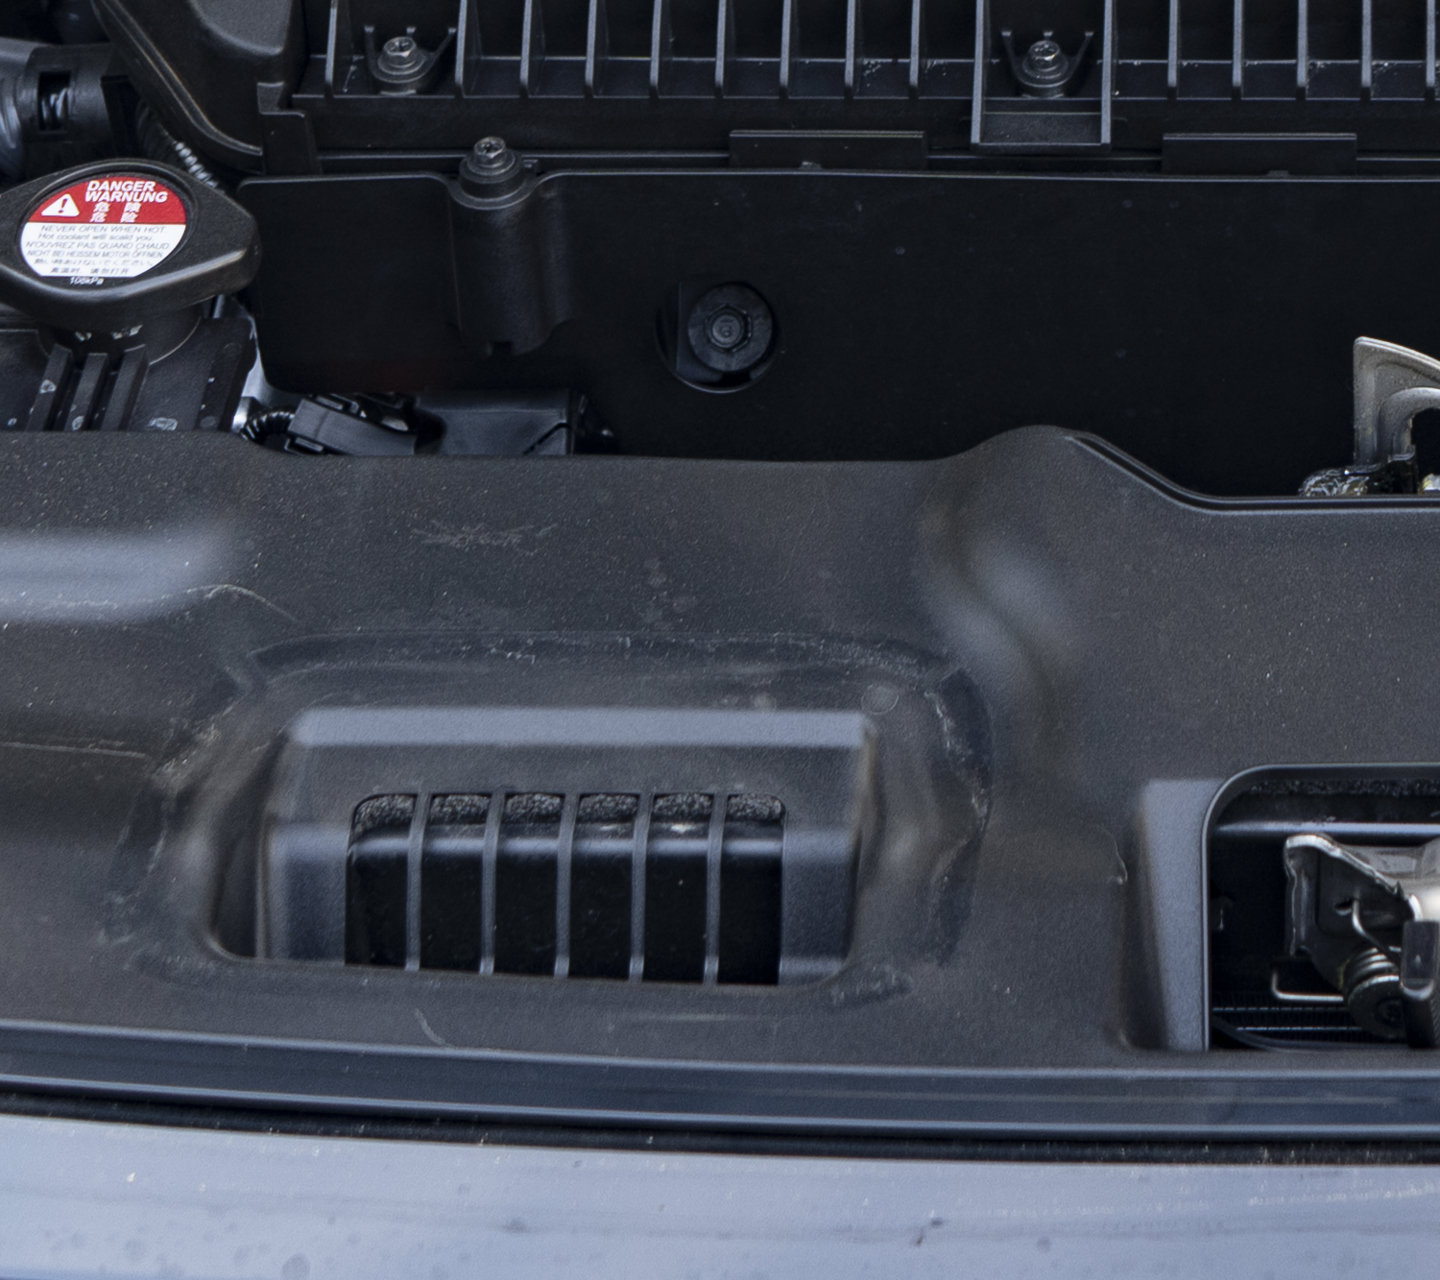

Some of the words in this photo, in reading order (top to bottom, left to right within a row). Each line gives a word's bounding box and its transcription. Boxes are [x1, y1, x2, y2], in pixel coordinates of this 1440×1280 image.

[87, 180, 156, 192] DANGER
[85, 191, 168, 203] WARNUNG
[111, 225, 143, 233] WHEN
[135, 242, 170, 250] CHAUD
[102, 250, 131, 258] MOTOR
